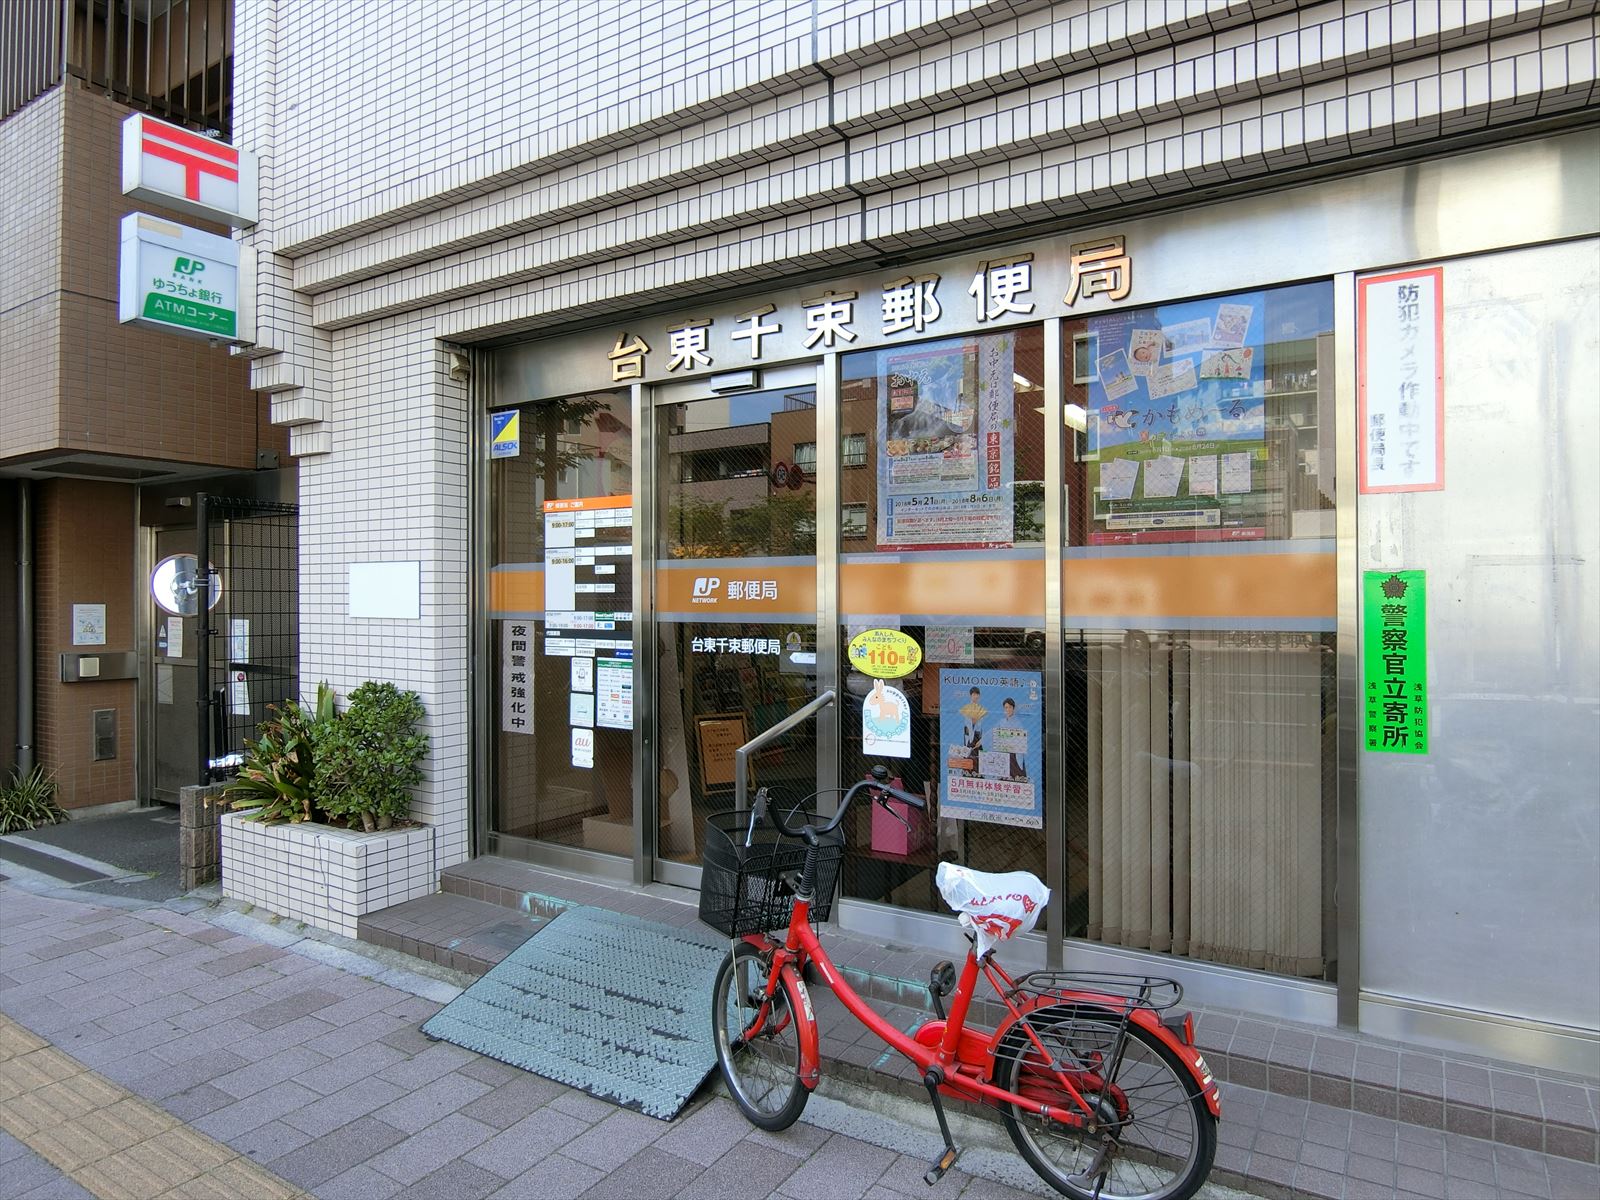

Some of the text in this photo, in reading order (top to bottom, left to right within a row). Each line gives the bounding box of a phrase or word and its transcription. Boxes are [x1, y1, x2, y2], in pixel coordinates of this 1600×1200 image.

[174, 256, 206, 275] JP
[153, 277, 223, 304] ゆうちょ銀行
[154, 299, 230, 321] ATMコーナー
[606, 234, 1133, 383] 台東千束郵便局
[494, 442, 518, 451] ALSOK
[692, 577, 721, 597] JP
[727, 580, 778, 600] 郵便局
[691, 637, 781, 655] 台東千束郵便局
[511, 625, 527, 729] 夜間警戒強化中
[1381, 603, 1409, 748] 警察官立寄所
[1368, 681, 1377, 748] 浅草警察署
[1414, 682, 1424, 750] 浅草防犯協会
[951, 778, 1021, 794] 5月無料体験学習
